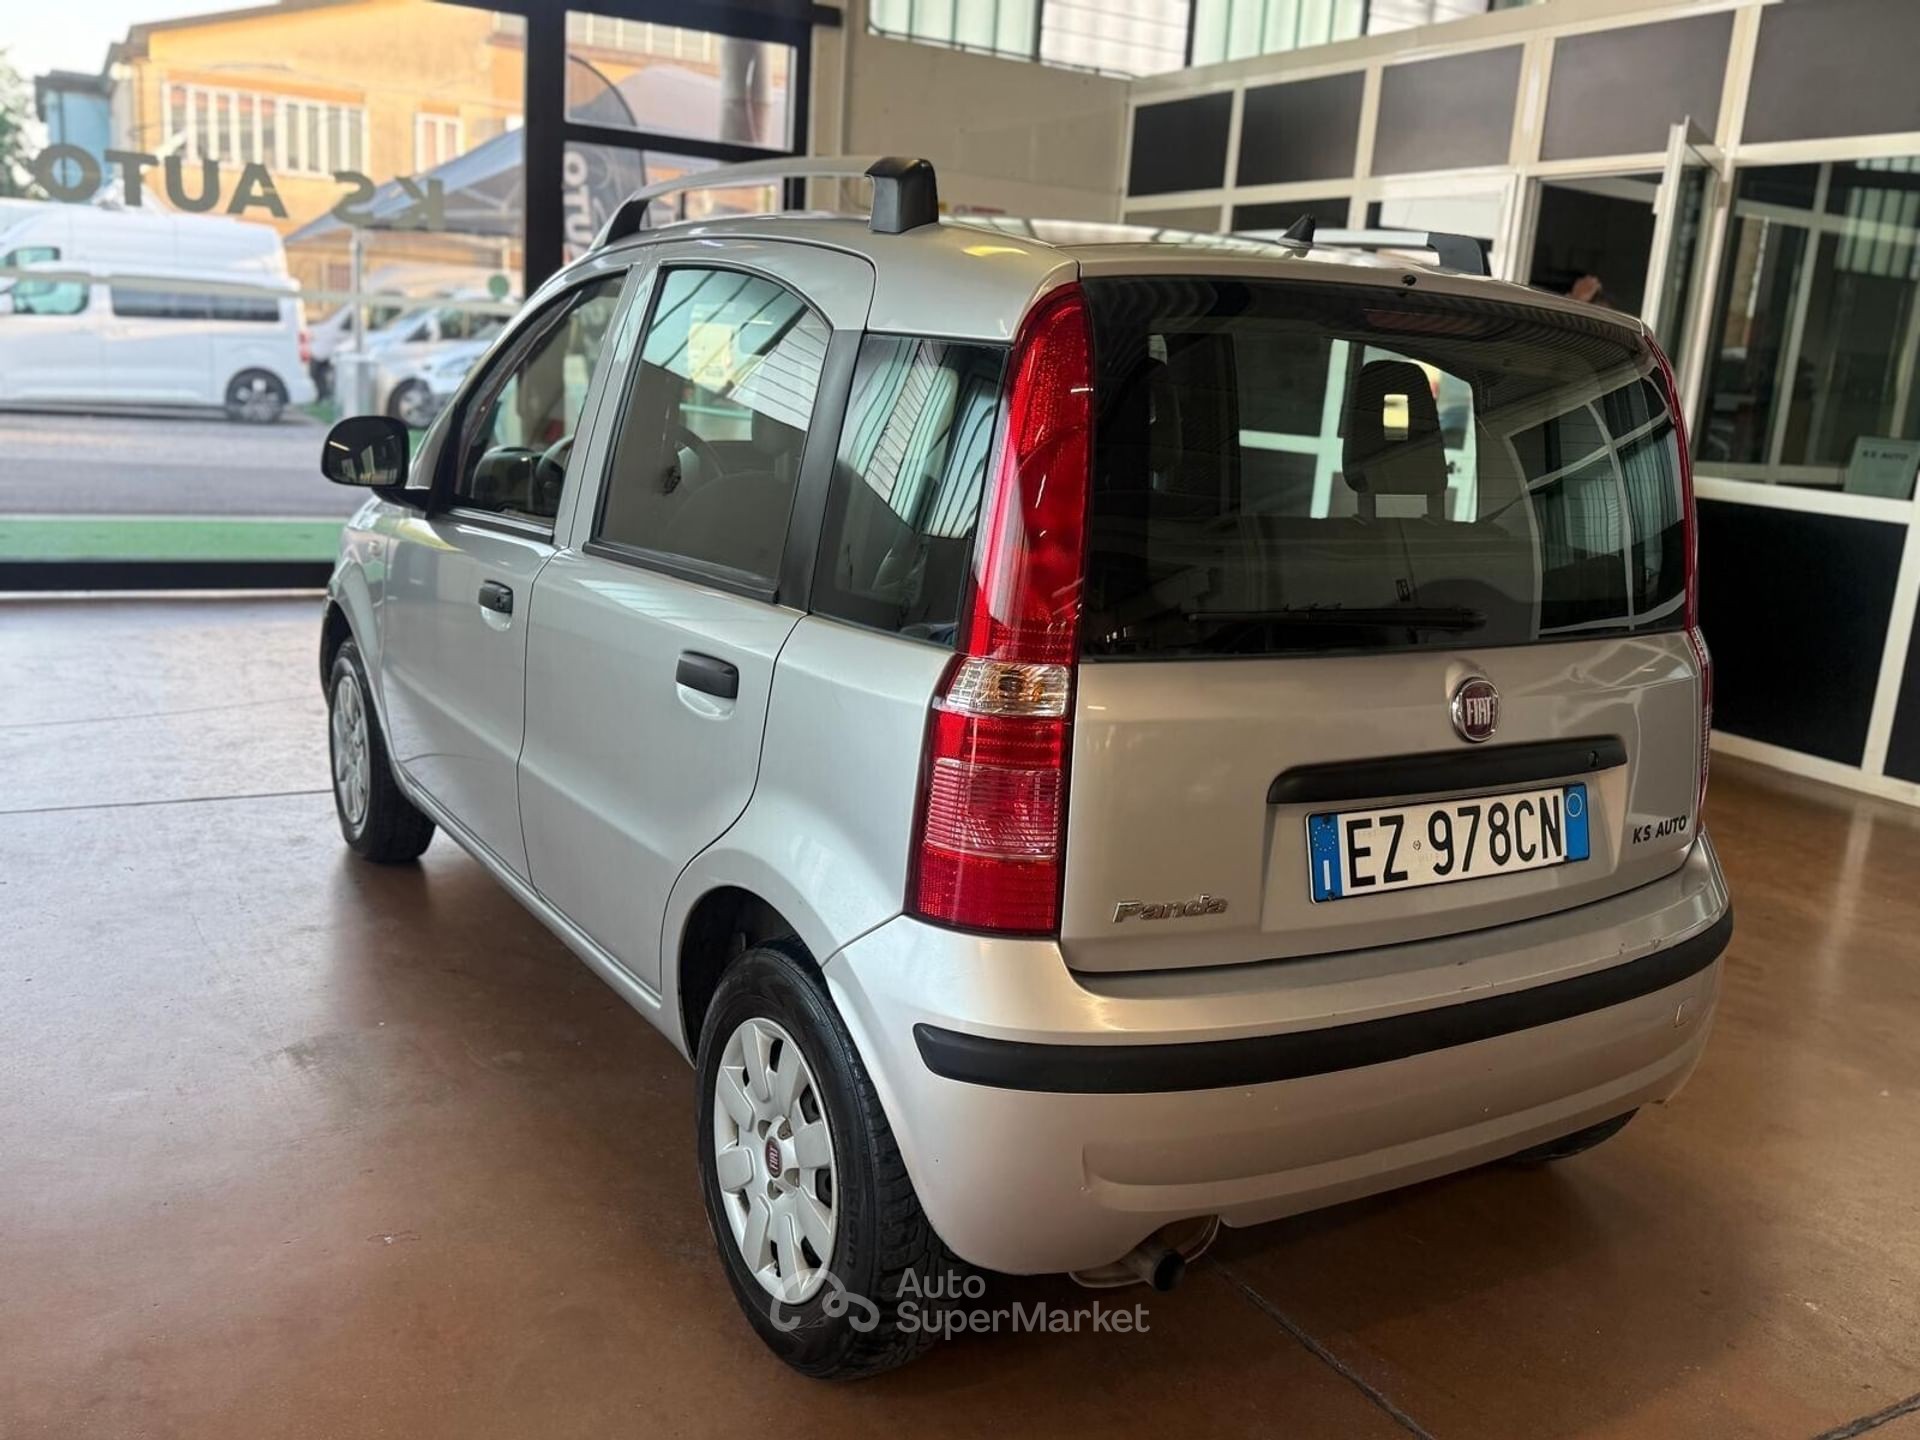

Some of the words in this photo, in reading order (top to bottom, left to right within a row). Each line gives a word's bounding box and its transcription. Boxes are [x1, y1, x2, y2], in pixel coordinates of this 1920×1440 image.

[1465, 696, 1492, 726] FIAT
[1346, 814, 1408, 888] EZ
[1427, 795, 1562, 876] 978CN
[1632, 825, 1652, 845] KS
[1655, 814, 1687, 838] AUTO
[1112, 893, 1228, 923] Panda
[769, 1144, 778, 1170] FIAT
